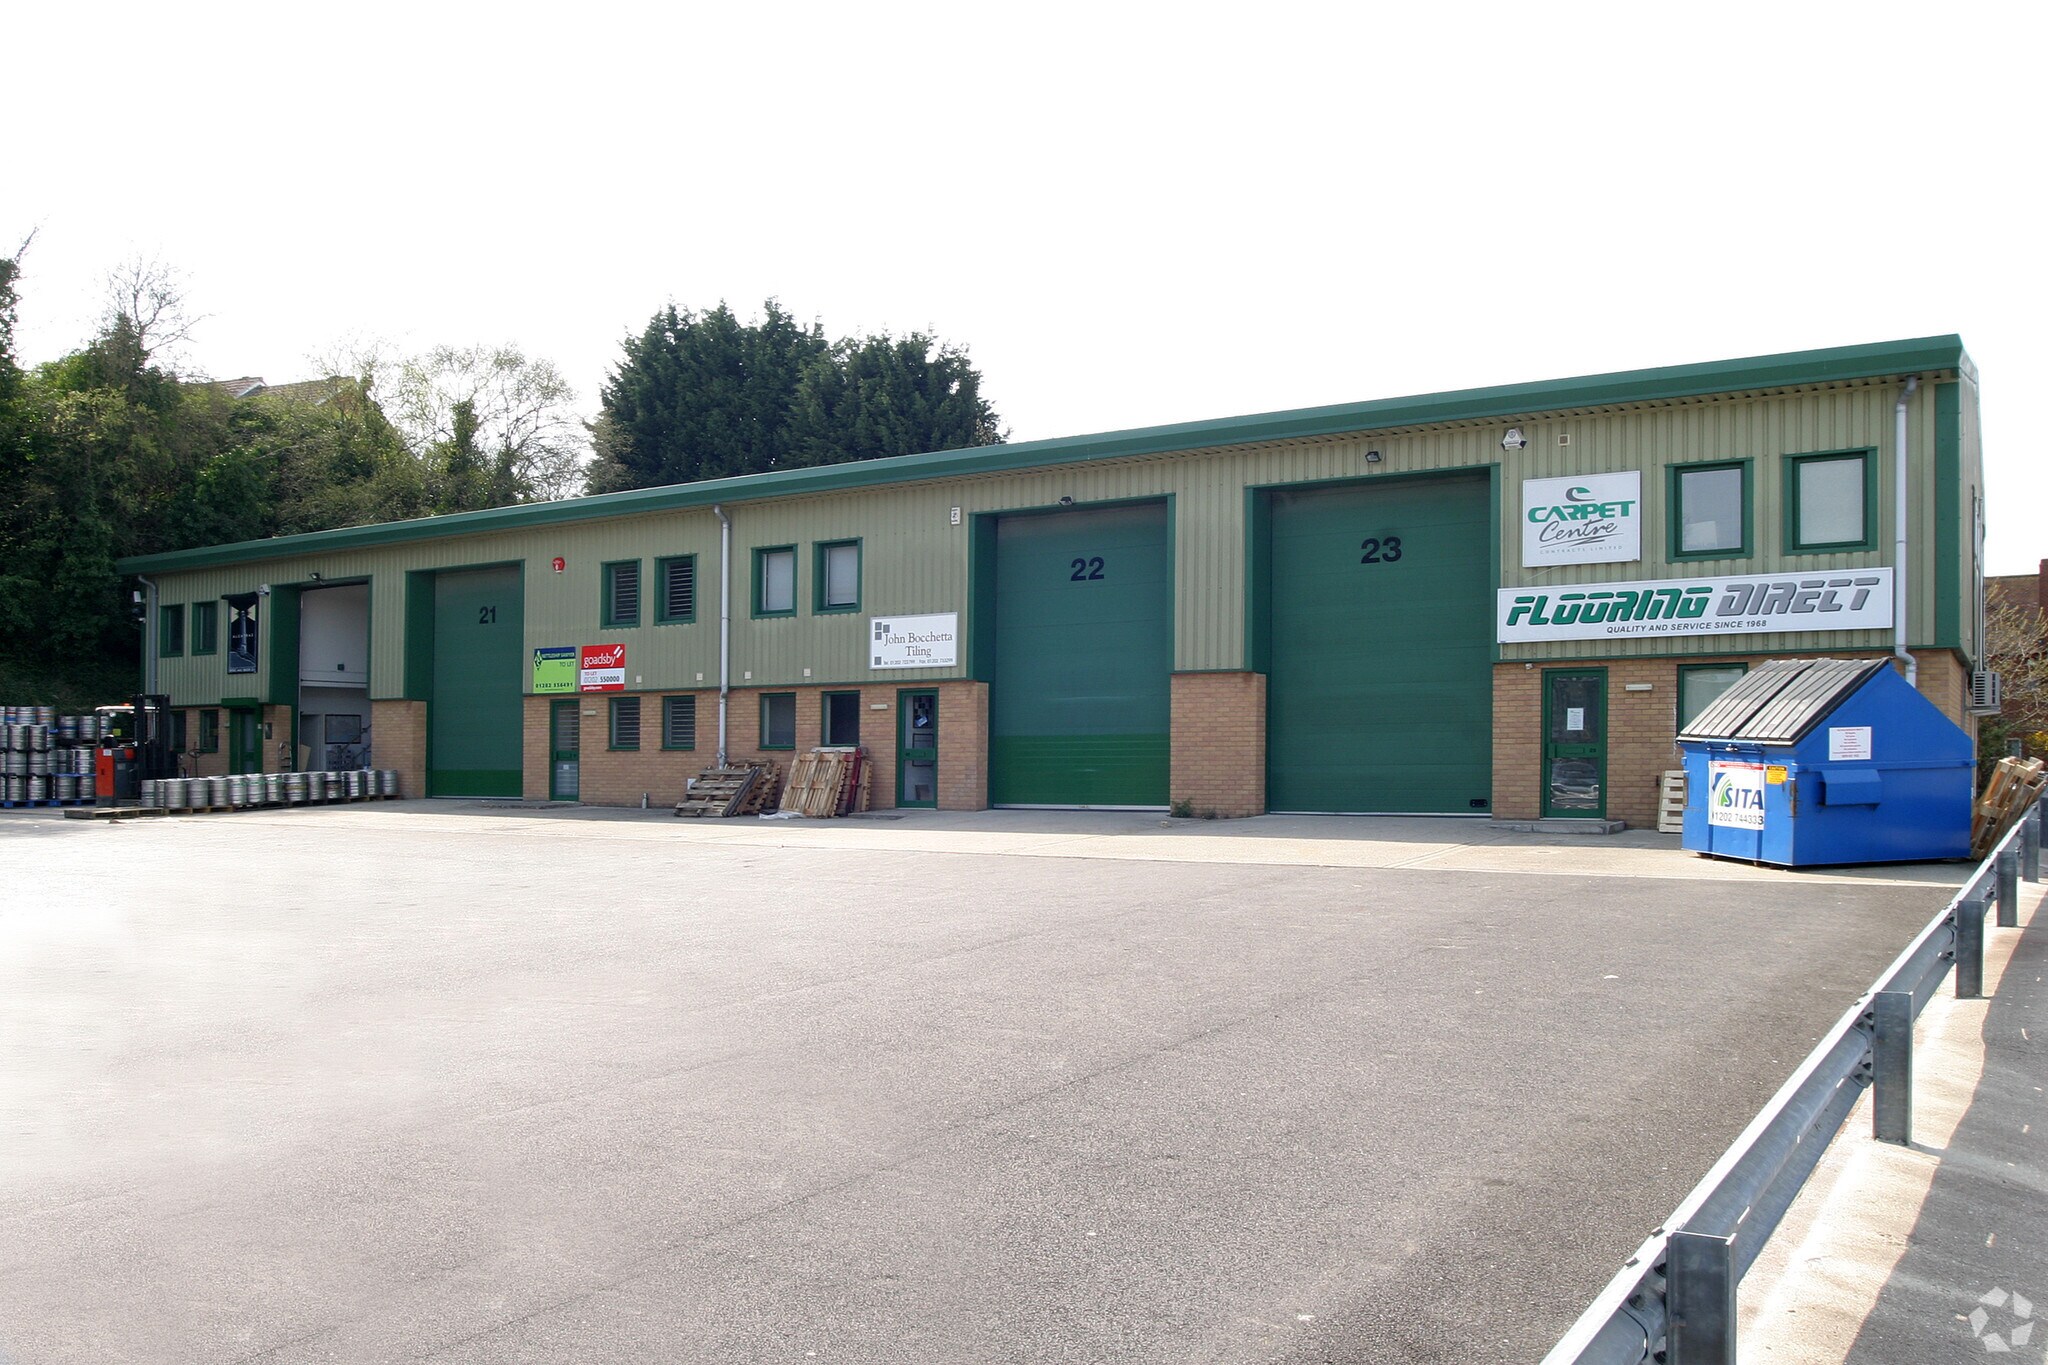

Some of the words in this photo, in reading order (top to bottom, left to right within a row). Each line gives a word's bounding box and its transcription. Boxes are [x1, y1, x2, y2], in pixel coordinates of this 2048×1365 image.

[1527, 500, 1636, 523] CARPET
[1539, 519, 1618, 542] Centre
[1361, 536, 1402, 564] 23
[1070, 556, 1105, 581] 22
[1506, 587, 1713, 626] FLOORING
[1715, 577, 1880, 616] DIRECT
[479, 605, 496, 624] 21
[1607, 625, 1647, 634] QUALITY
[1649, 623, 1668, 632] AND
[1670, 622, 1712, 631] SERVICE
[1714, 620, 1743, 629] SINCE
[1746, 619, 1767, 627] 1968
[884, 633, 906, 646] John
[908, 631, 953, 643] Bocchetta
[583, 652, 616, 669] goadsby
[905, 645, 932, 658] Tiling
[600, 675, 620, 683] 550000
[1724, 787, 1764, 810] SITA
[1735, 813, 1764, 825] 744333
